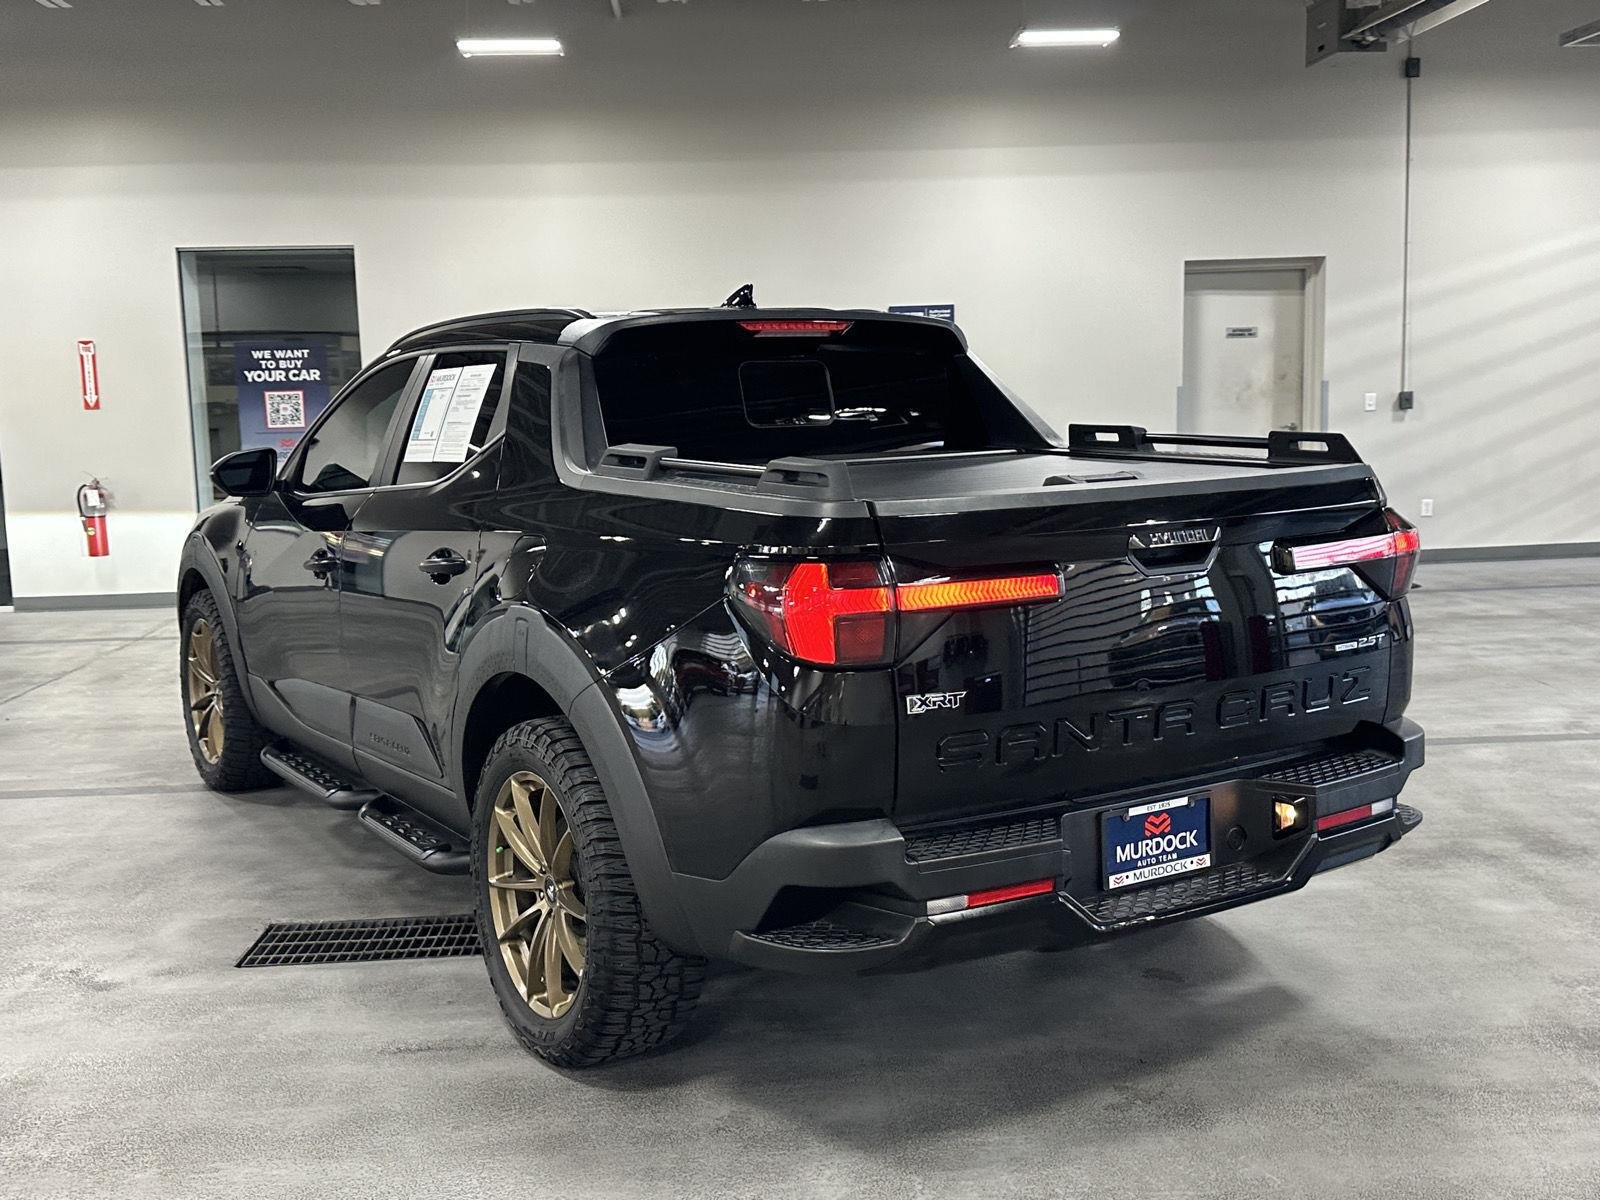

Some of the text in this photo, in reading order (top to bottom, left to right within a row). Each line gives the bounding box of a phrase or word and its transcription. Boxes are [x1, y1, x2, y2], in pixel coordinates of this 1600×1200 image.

[251, 349, 310, 359] WE WANT
[259, 359, 303, 369] TO BUY
[243, 369, 321, 382] YOUR CAR
[1149, 528, 1209, 545] HYUNDAI
[935, 664, 1371, 773] SANTA CRUZ
[1116, 829, 1198, 863] MURDOCK
[1137, 852, 1178, 867] AUTO TEAM
[1133, 860, 1188, 881] MURDOCK
